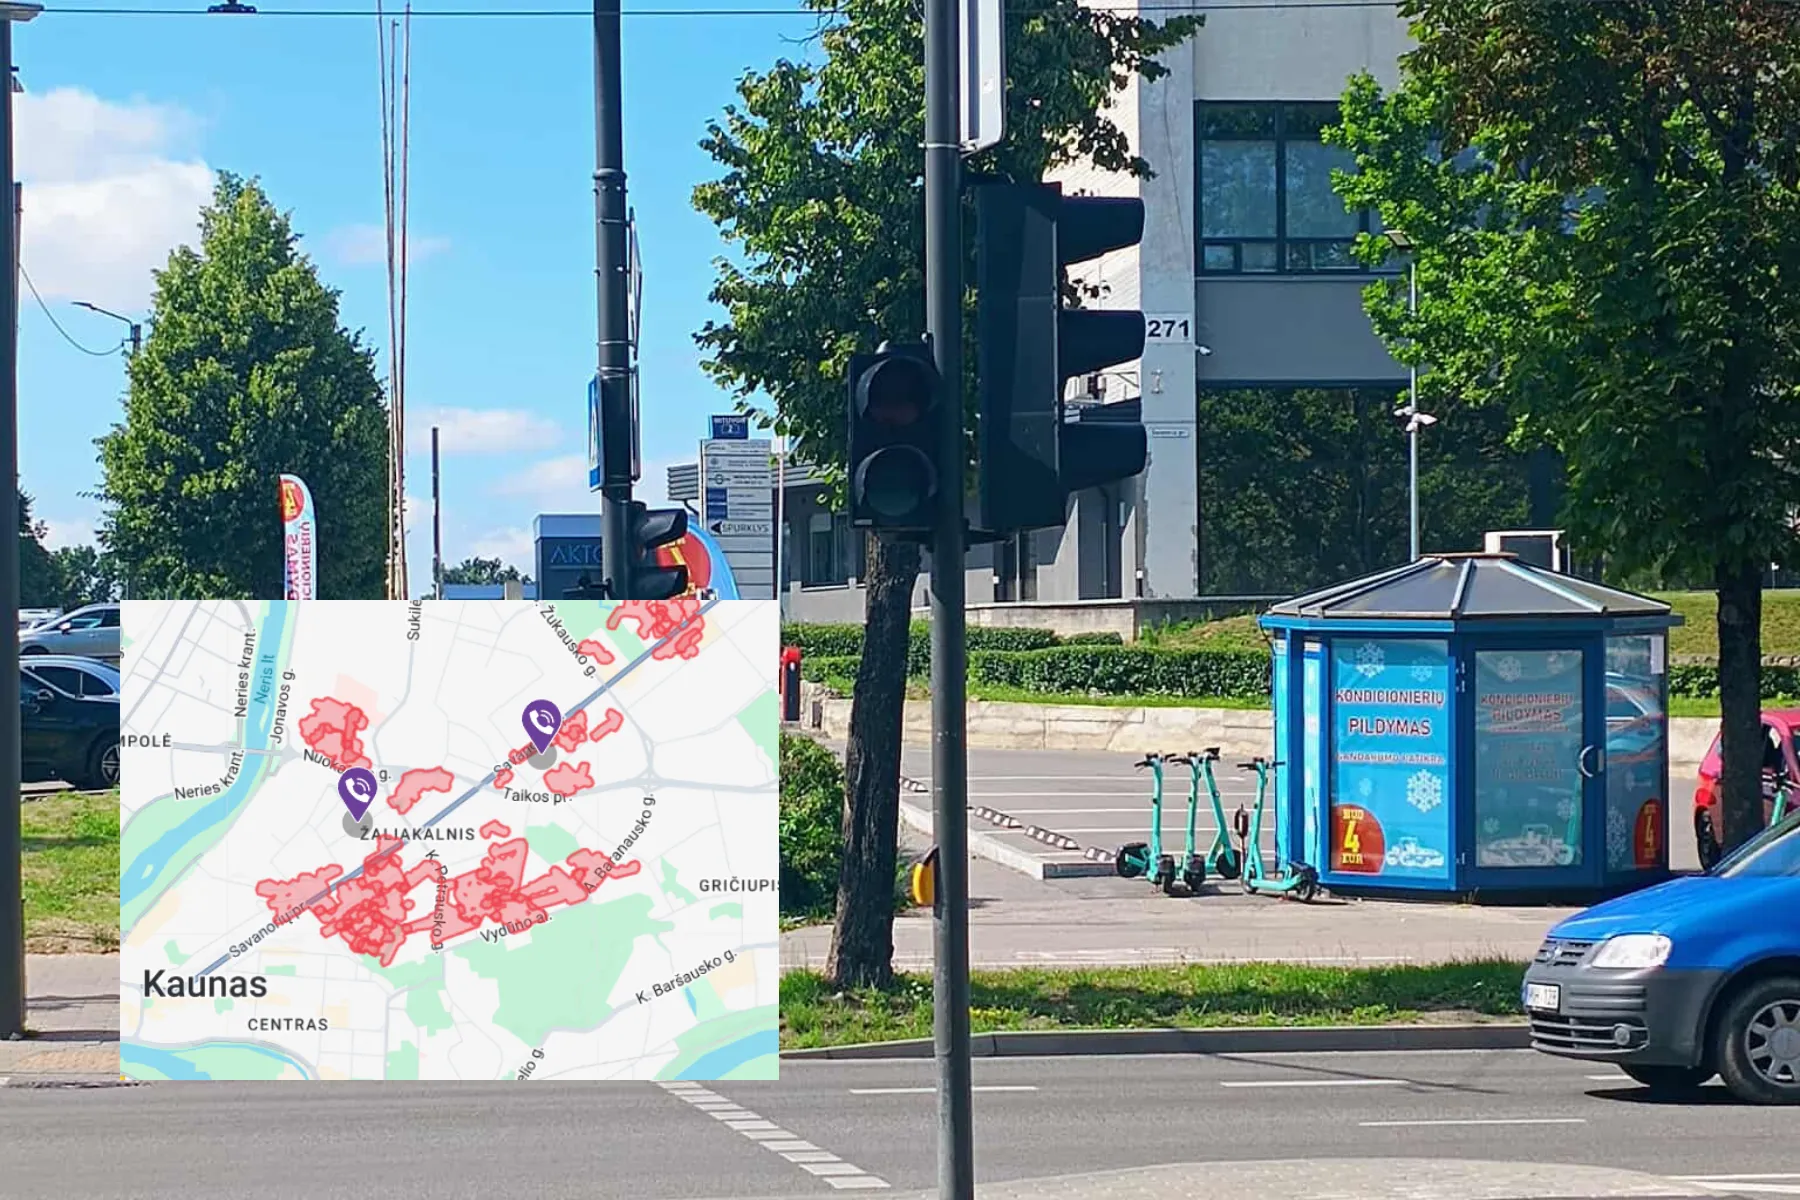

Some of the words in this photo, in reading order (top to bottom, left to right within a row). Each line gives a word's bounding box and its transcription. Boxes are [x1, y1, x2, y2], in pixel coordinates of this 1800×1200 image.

[1148, 320, 1189, 338] 271
[1335, 689, 1445, 708] KONDICIONIERIŲ
[1348, 717, 1432, 736] PILDYMAS
[1343, 820, 1361, 853] 4
